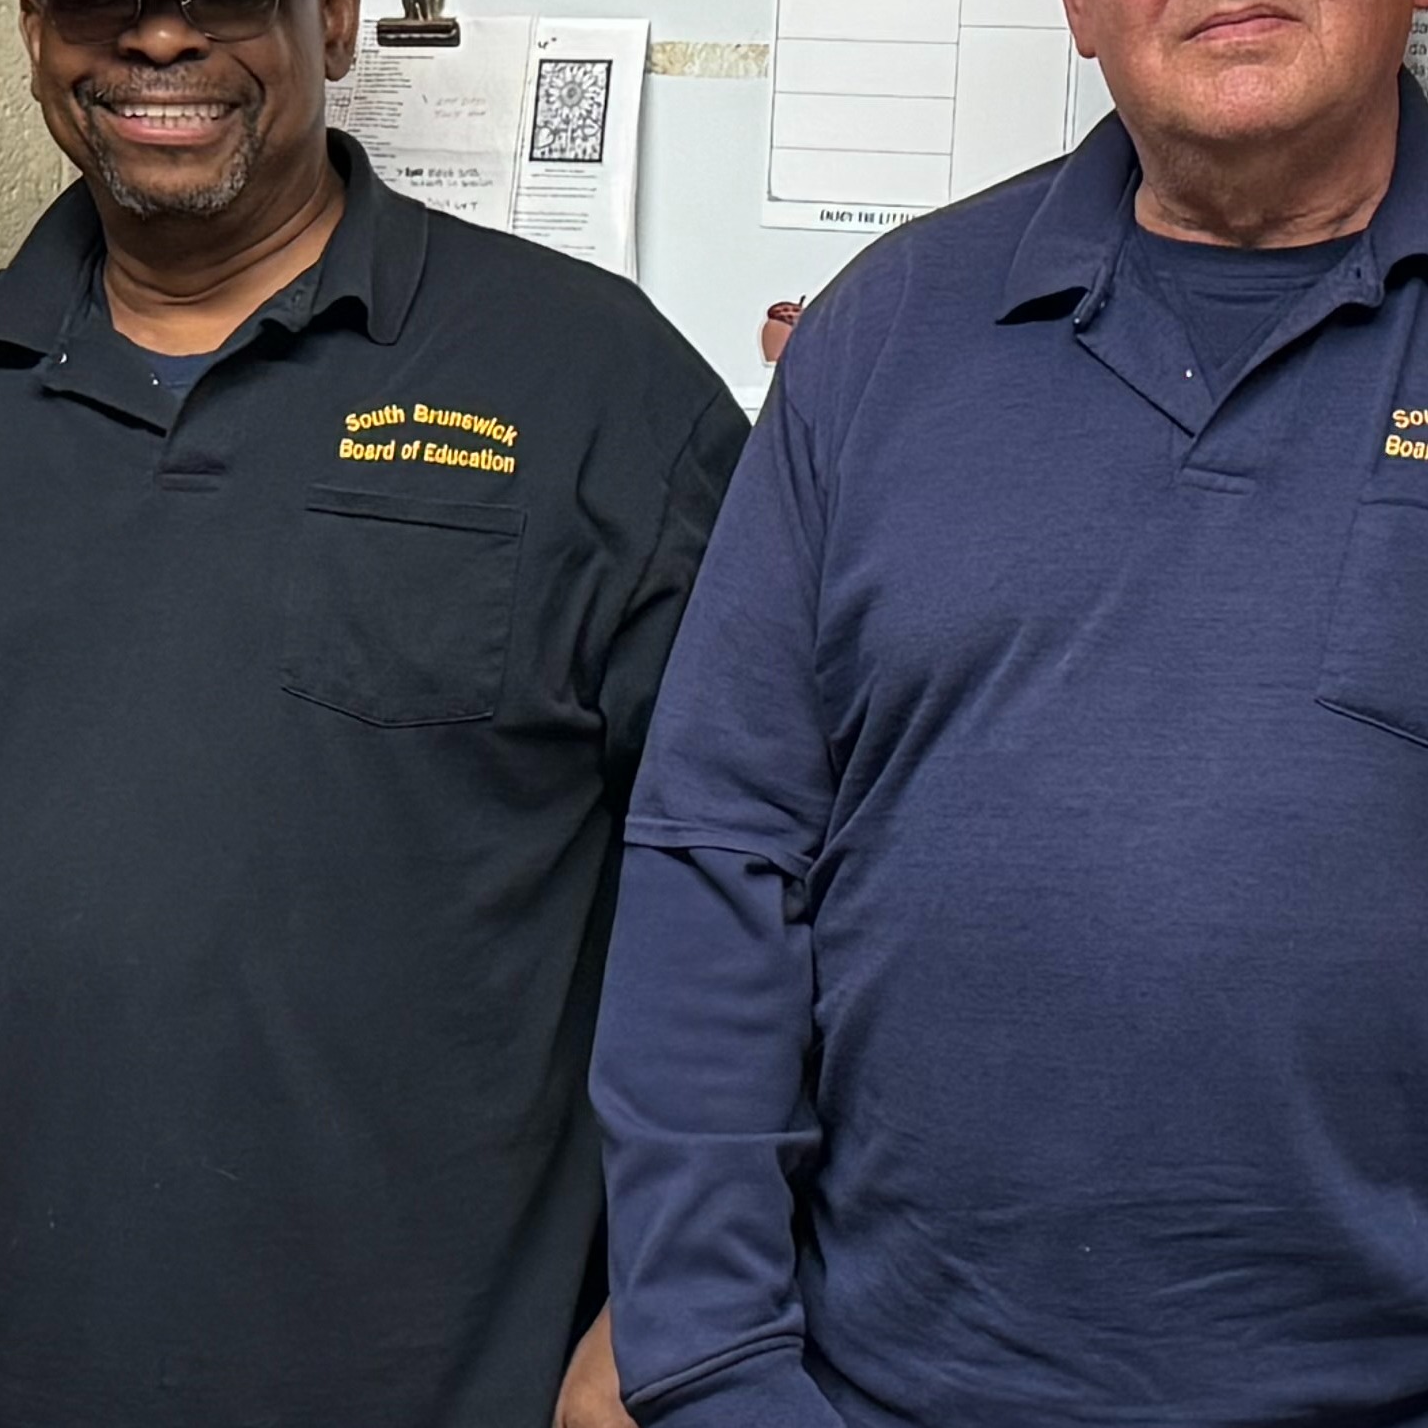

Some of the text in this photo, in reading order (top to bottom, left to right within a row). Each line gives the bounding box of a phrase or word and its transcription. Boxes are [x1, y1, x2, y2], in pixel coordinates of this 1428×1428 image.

[820, 209, 853, 222] ENJOY
[344, 403, 519, 448] South Brunswick
[339, 438, 516, 474] Board of Education
